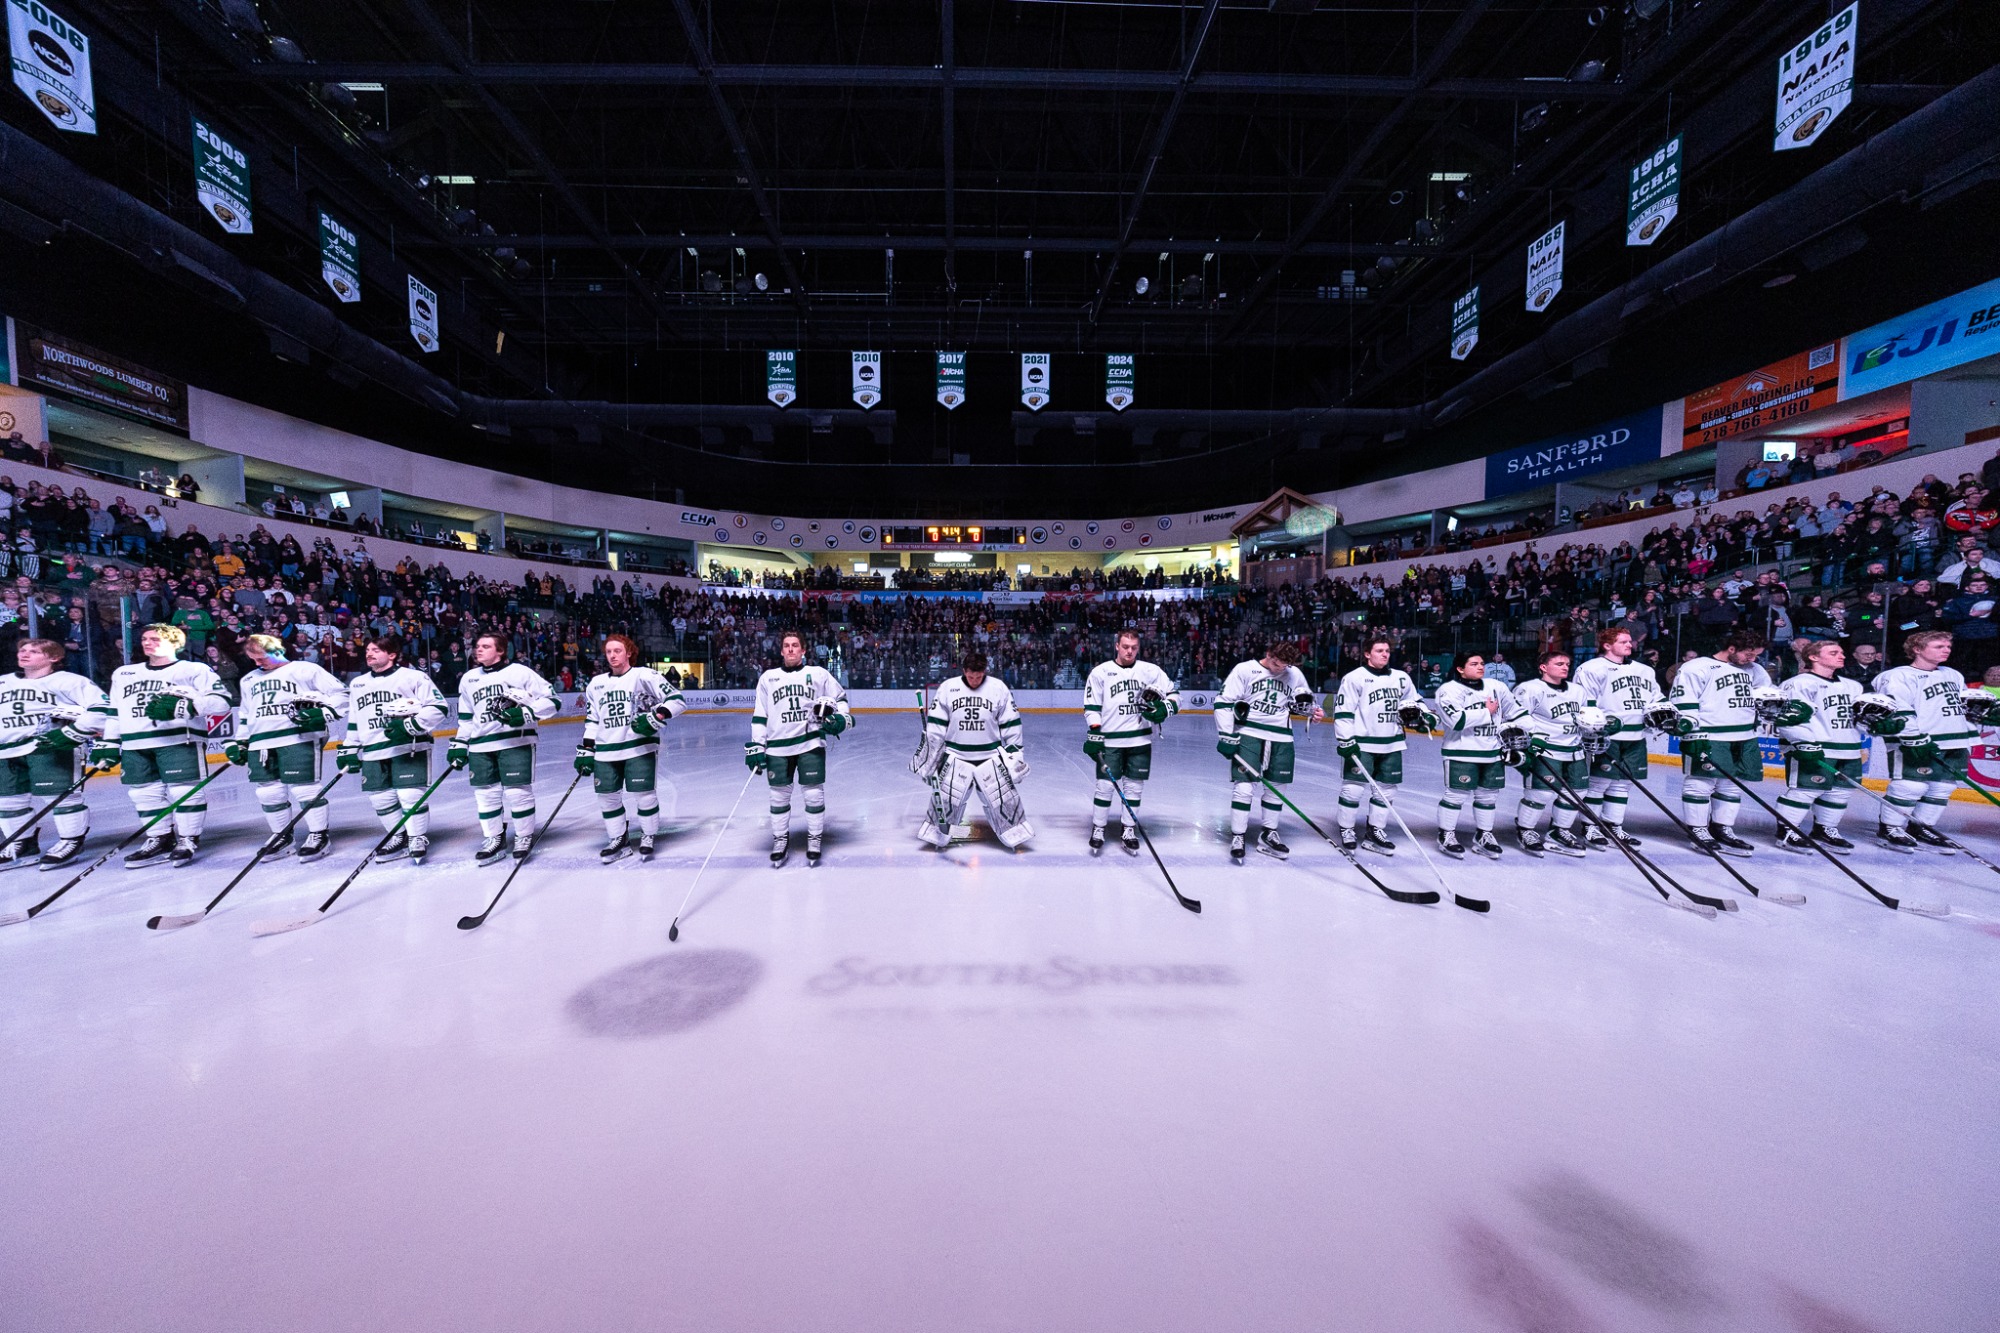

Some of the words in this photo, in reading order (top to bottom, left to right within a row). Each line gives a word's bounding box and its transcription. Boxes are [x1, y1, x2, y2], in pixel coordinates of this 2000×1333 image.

[1783, 9, 1853, 74] 1969
[33, 41, 75, 75] NCAA
[1781, 40, 1850, 98] NAIA
[13, 58, 94, 114] TOURNAMENT
[1785, 59, 1845, 105] National
[1776, 79, 1851, 133] CHAMPIONS
[195, 122, 247, 169] 2008
[1632, 138, 1679, 184] 1969
[200, 166, 249, 202] Conference
[1631, 162, 1678, 203] ICHA
[198, 180, 252, 219] CHAMPIONS
[1631, 177, 1678, 211] Conference
[1628, 194, 1678, 231] CHAMPIONS
[321, 213, 357, 247] 2009
[1530, 225, 1562, 258] 1968
[1529, 246, 1561, 274] NAIA
[410, 279, 436, 304] 2009
[1453, 286, 1479, 314] 1967
[1453, 304, 1478, 327] ICHA
[768, 351, 794, 361] 2010
[854, 353, 879, 363] 2010
[938, 354, 964, 363] 2017
[1024, 355, 1048, 364] 2021
[1107, 355, 1133, 365] 2024
[42, 344, 115, 378] NORTHWOODS
[116, 371, 154, 395] LUMBER
[154, 386, 170, 402] CO.
[1701, 403, 1739, 422] BEAVER
[1742, 383, 1791, 408] ROOFING
[1794, 375, 1816, 390] LLC
[1700, 415, 1727, 430] ROOFING
[1731, 406, 1754, 420] SIDING
[1759, 386, 1815, 410] CONSTRUCTION
[1703, 398, 1810, 443] 218-766-4180
[1507, 428, 1631, 474] SANFORD
[1528, 454, 1603, 480] HEALTH
[680, 511, 717, 526] CCHA
[806, 673, 813, 686] A
[1399, 677, 1406, 689] C
[1611, 675, 1653, 693] BEMIDJI
[1715, 673, 1753, 691] BEMID
[0, 688, 58, 706] EMIDJI
[261, 691, 277, 705] 17
[432, 689, 444, 700] 5
[472, 684, 504, 706] BEMID
[772, 684, 815, 705] BEMIDJI
[1127, 691, 1135, 703] 2
[1263, 690, 1278, 704] 14
[1369, 687, 1400, 705] BEMID
[1629, 687, 1642, 699] 16
[1734, 685, 1751, 697] 26
[1923, 681, 1960, 700] BEMID
[13, 702, 25, 715] 9
[375, 704, 383, 717] 5
[608, 702, 625, 717] 22
[788, 697, 801, 711] 11
[952, 696, 993, 713] BEMIDJI
[1119, 704, 1144, 716] STAT
[1384, 699, 1398, 712] 20
[1551, 701, 1580, 719] BEMID
[1728, 698, 1755, 708] STATE
[1823, 694, 1852, 711] BEMI
[3, 713, 49, 729] STATE
[604, 716, 631, 729] STATE
[781, 710, 809, 723] STATE
[964, 708, 980, 720] 35
[220, 722, 231, 735] A
[959, 720, 985, 731] STATE
[1474, 725, 1498, 737] STATE
[1831, 719, 1853, 729] STA
[939, 762, 951, 784] UGHN
